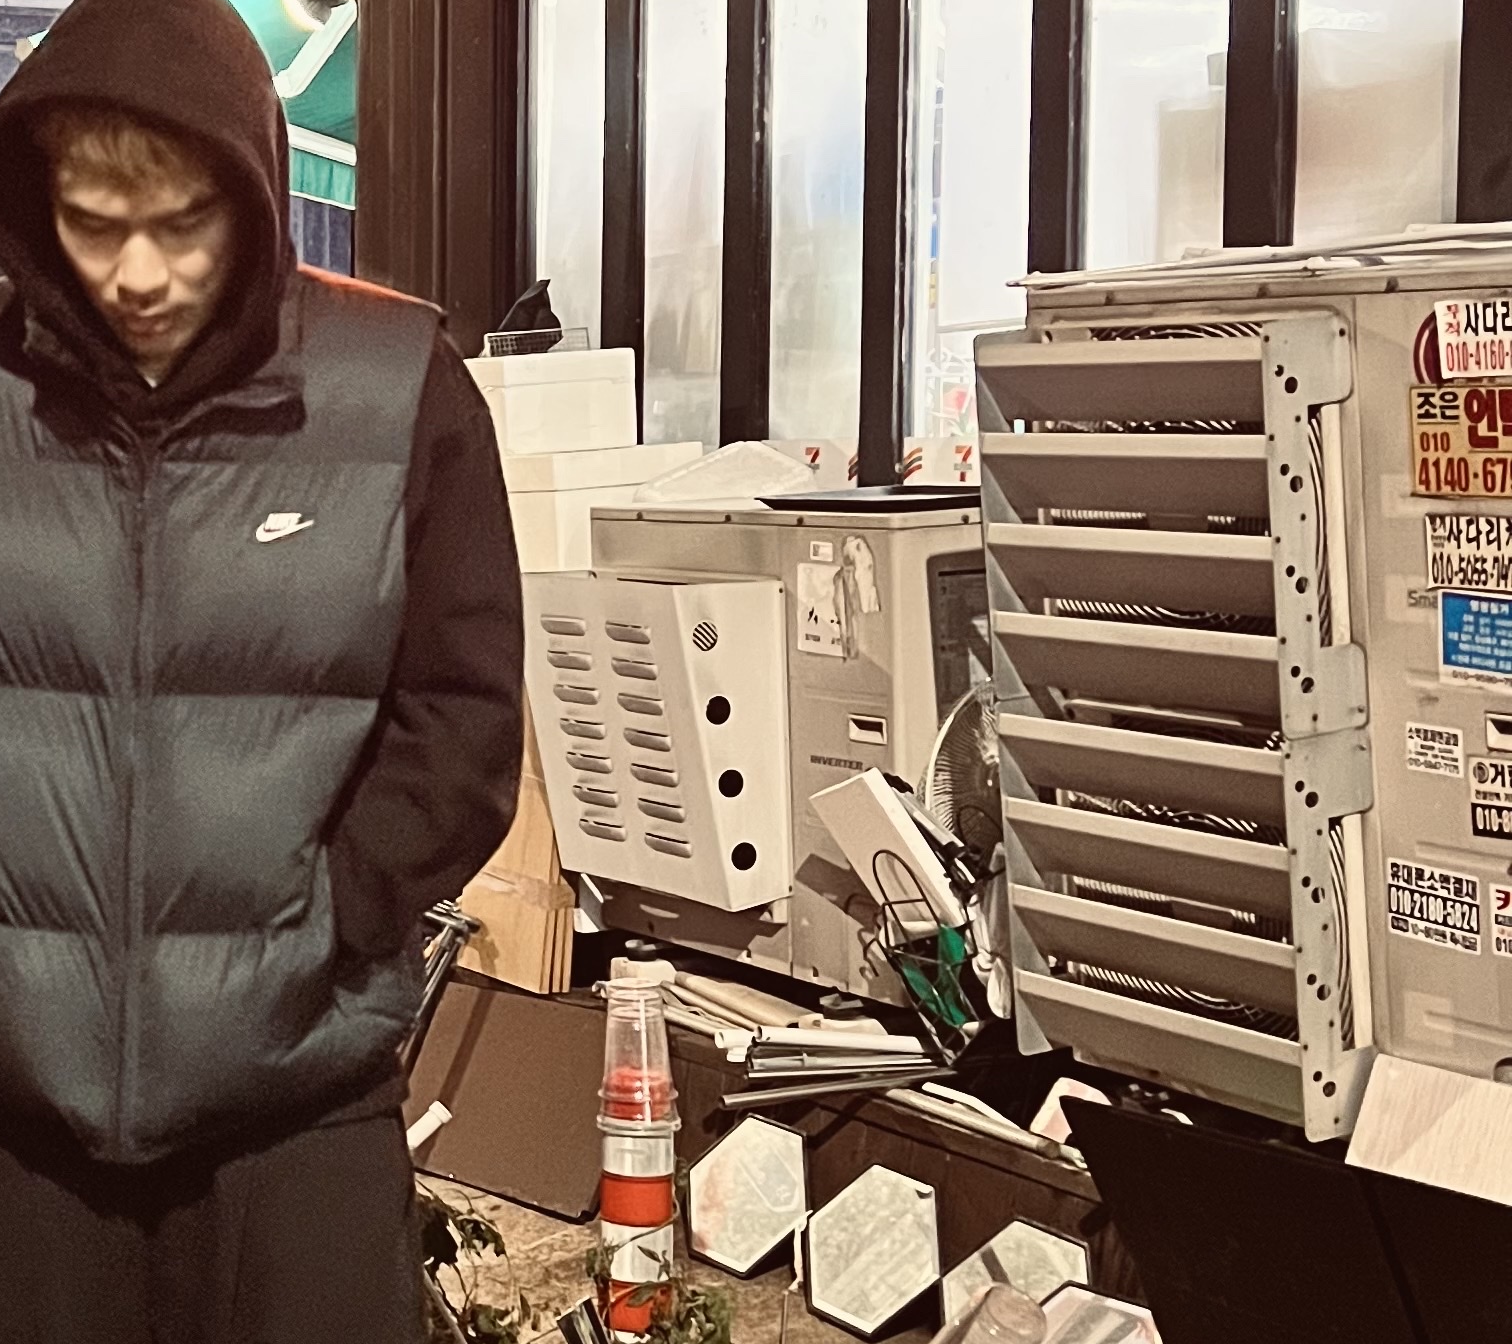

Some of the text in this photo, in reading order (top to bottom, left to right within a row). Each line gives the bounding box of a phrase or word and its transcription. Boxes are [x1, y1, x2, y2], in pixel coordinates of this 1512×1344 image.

[1416, 391, 1460, 421] 조은
[1420, 432, 1450, 453] 010
[1475, 806, 1512, 833] 010-8
